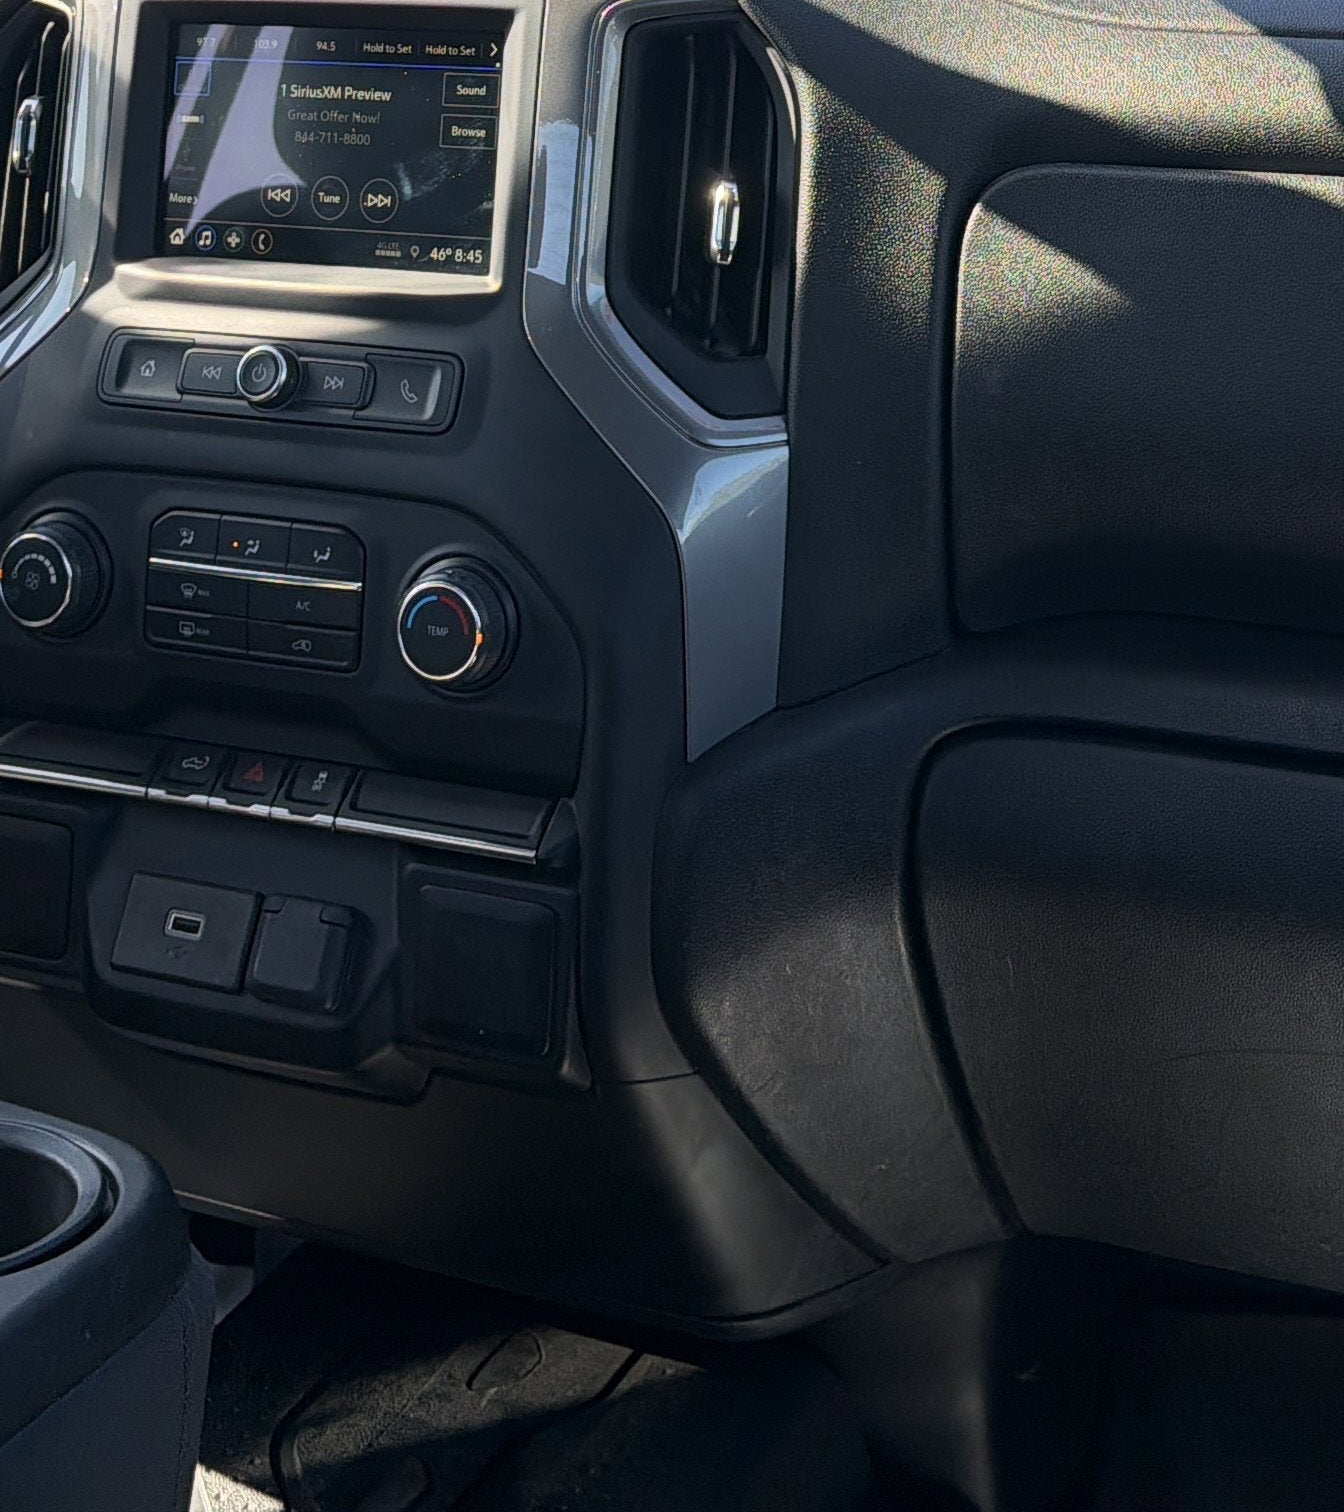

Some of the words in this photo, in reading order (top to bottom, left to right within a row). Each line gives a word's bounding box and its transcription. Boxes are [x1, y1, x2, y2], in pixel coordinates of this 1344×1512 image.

[316, 41, 336, 52] 94.5
[363, 43, 385, 53] Hold
[385, 44, 396, 53] to
[396, 44, 413, 54] Set
[425, 45, 447, 55] Hold
[447, 46, 459, 56] to
[459, 45, 476, 57] Set
[289, 85, 342, 99] SiriusXM
[344, 86, 392, 101] Preview
[456, 84, 487, 96] Sound
[287, 109, 318, 121] Great
[320, 110, 349, 123] Offer
[352, 111, 381, 124] Now!
[294, 131, 371, 145] 844-711-8800
[451, 126, 487, 138] Browse
[169, 192, 193, 204] More
[318, 191, 341, 204] Tune
[454, 248, 483, 264] 8:45
[295, 600, 311, 612] A/C
[427, 625, 449, 637] TEMP
